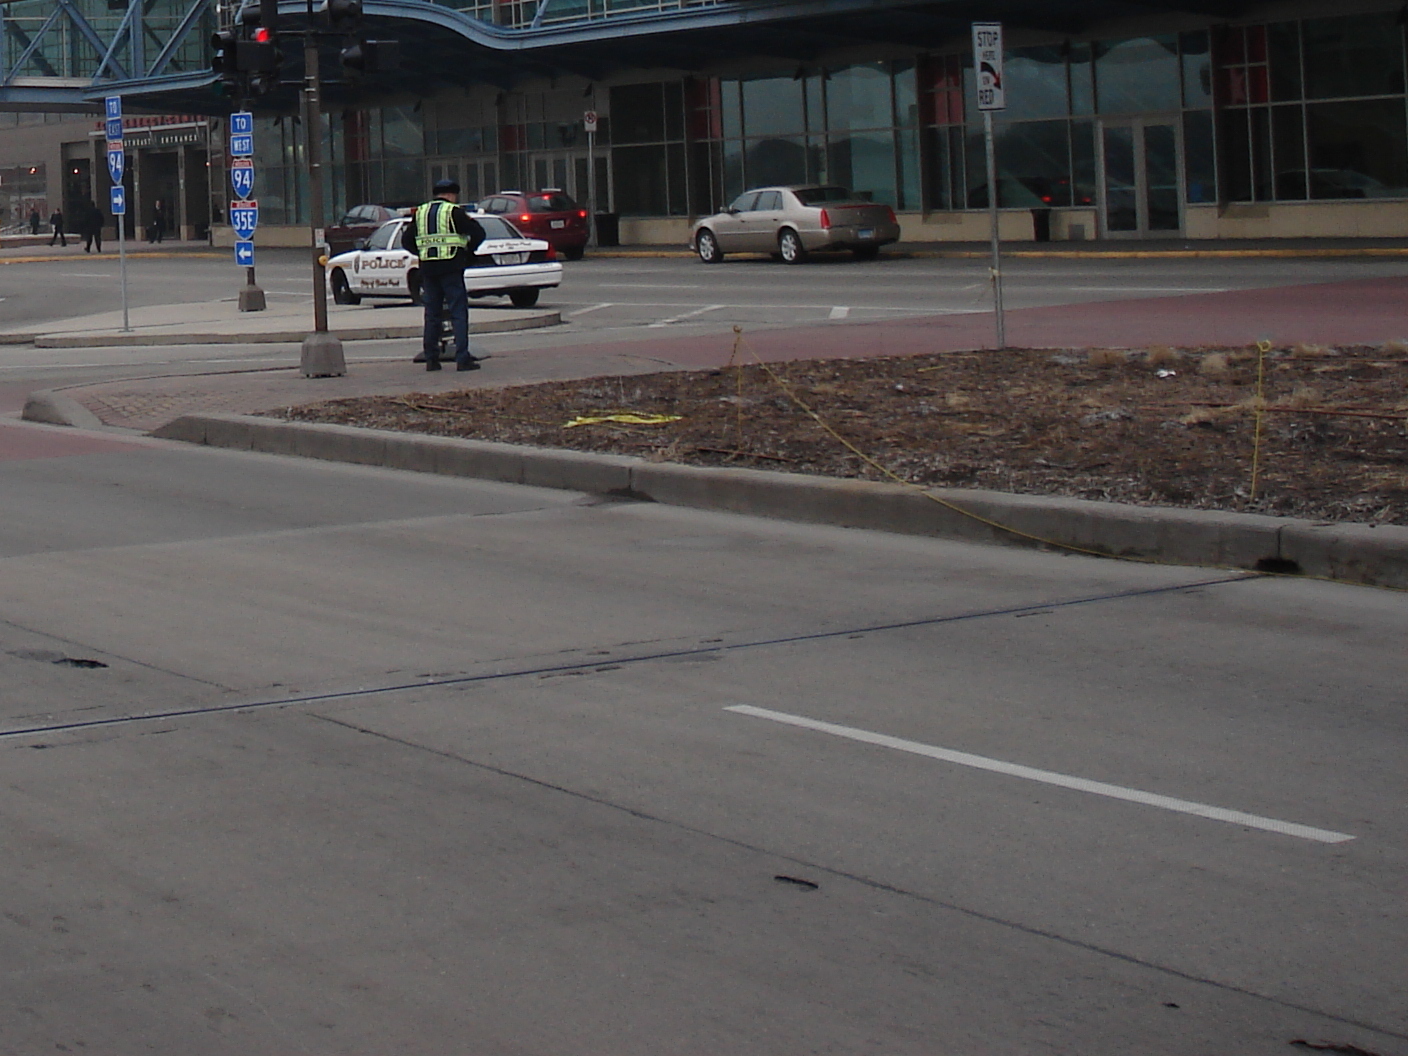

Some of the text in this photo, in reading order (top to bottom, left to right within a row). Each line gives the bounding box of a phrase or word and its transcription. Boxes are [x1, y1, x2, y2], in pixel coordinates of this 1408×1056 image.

[977, 31, 998, 47] STOP
[978, 89, 994, 104] RED
[108, 101, 117, 114] TO
[108, 123, 120, 136] EAST
[235, 117, 246, 130] TO
[233, 139, 250, 152] WEST
[109, 153, 122, 173] 94
[234, 170, 251, 189] 94
[234, 211, 254, 230] 35E
[361, 259, 406, 270] POLICE
